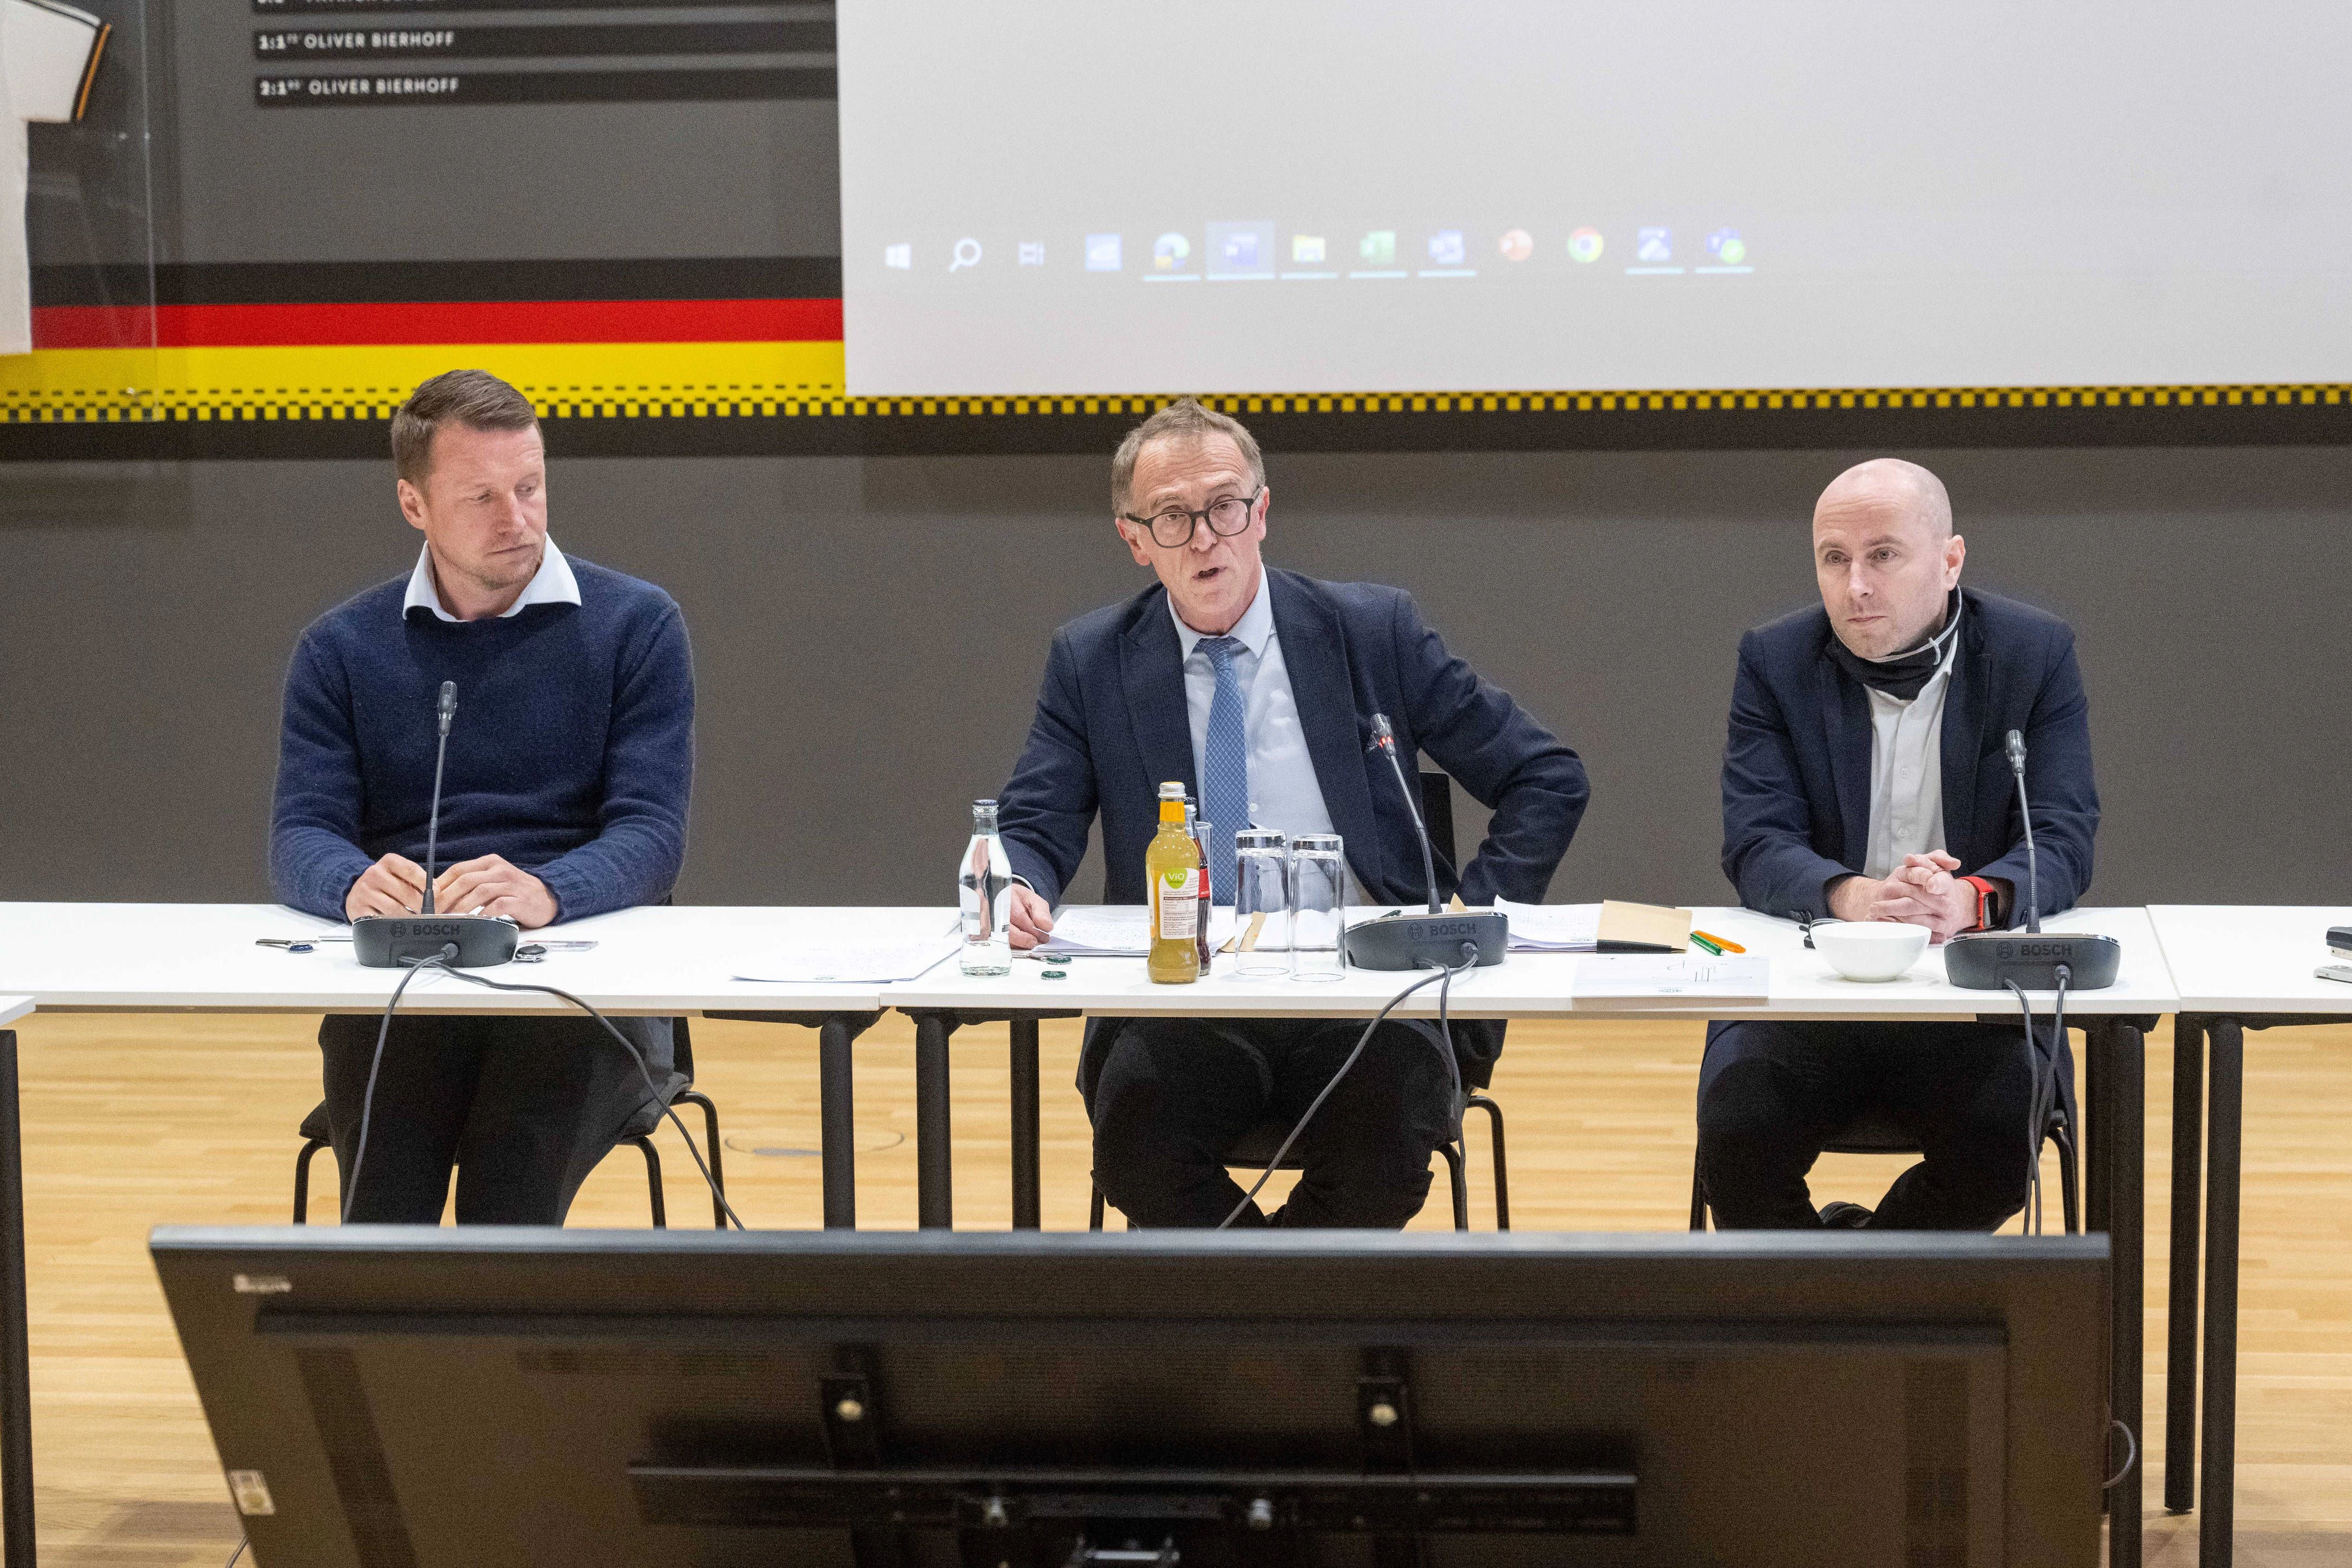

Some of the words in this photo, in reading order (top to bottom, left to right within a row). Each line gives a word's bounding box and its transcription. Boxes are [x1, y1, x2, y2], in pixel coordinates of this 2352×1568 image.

[304, 33, 366, 49] OLIVER
[371, 31, 455, 47] BIERHOFF
[308, 78, 370, 95] OLIVER
[376, 77, 459, 94] BIERHOFF
[412, 924, 460, 936] BOSCH
[1429, 923, 1476, 936] BOSCH
[2021, 944, 2072, 956] BOSCH
